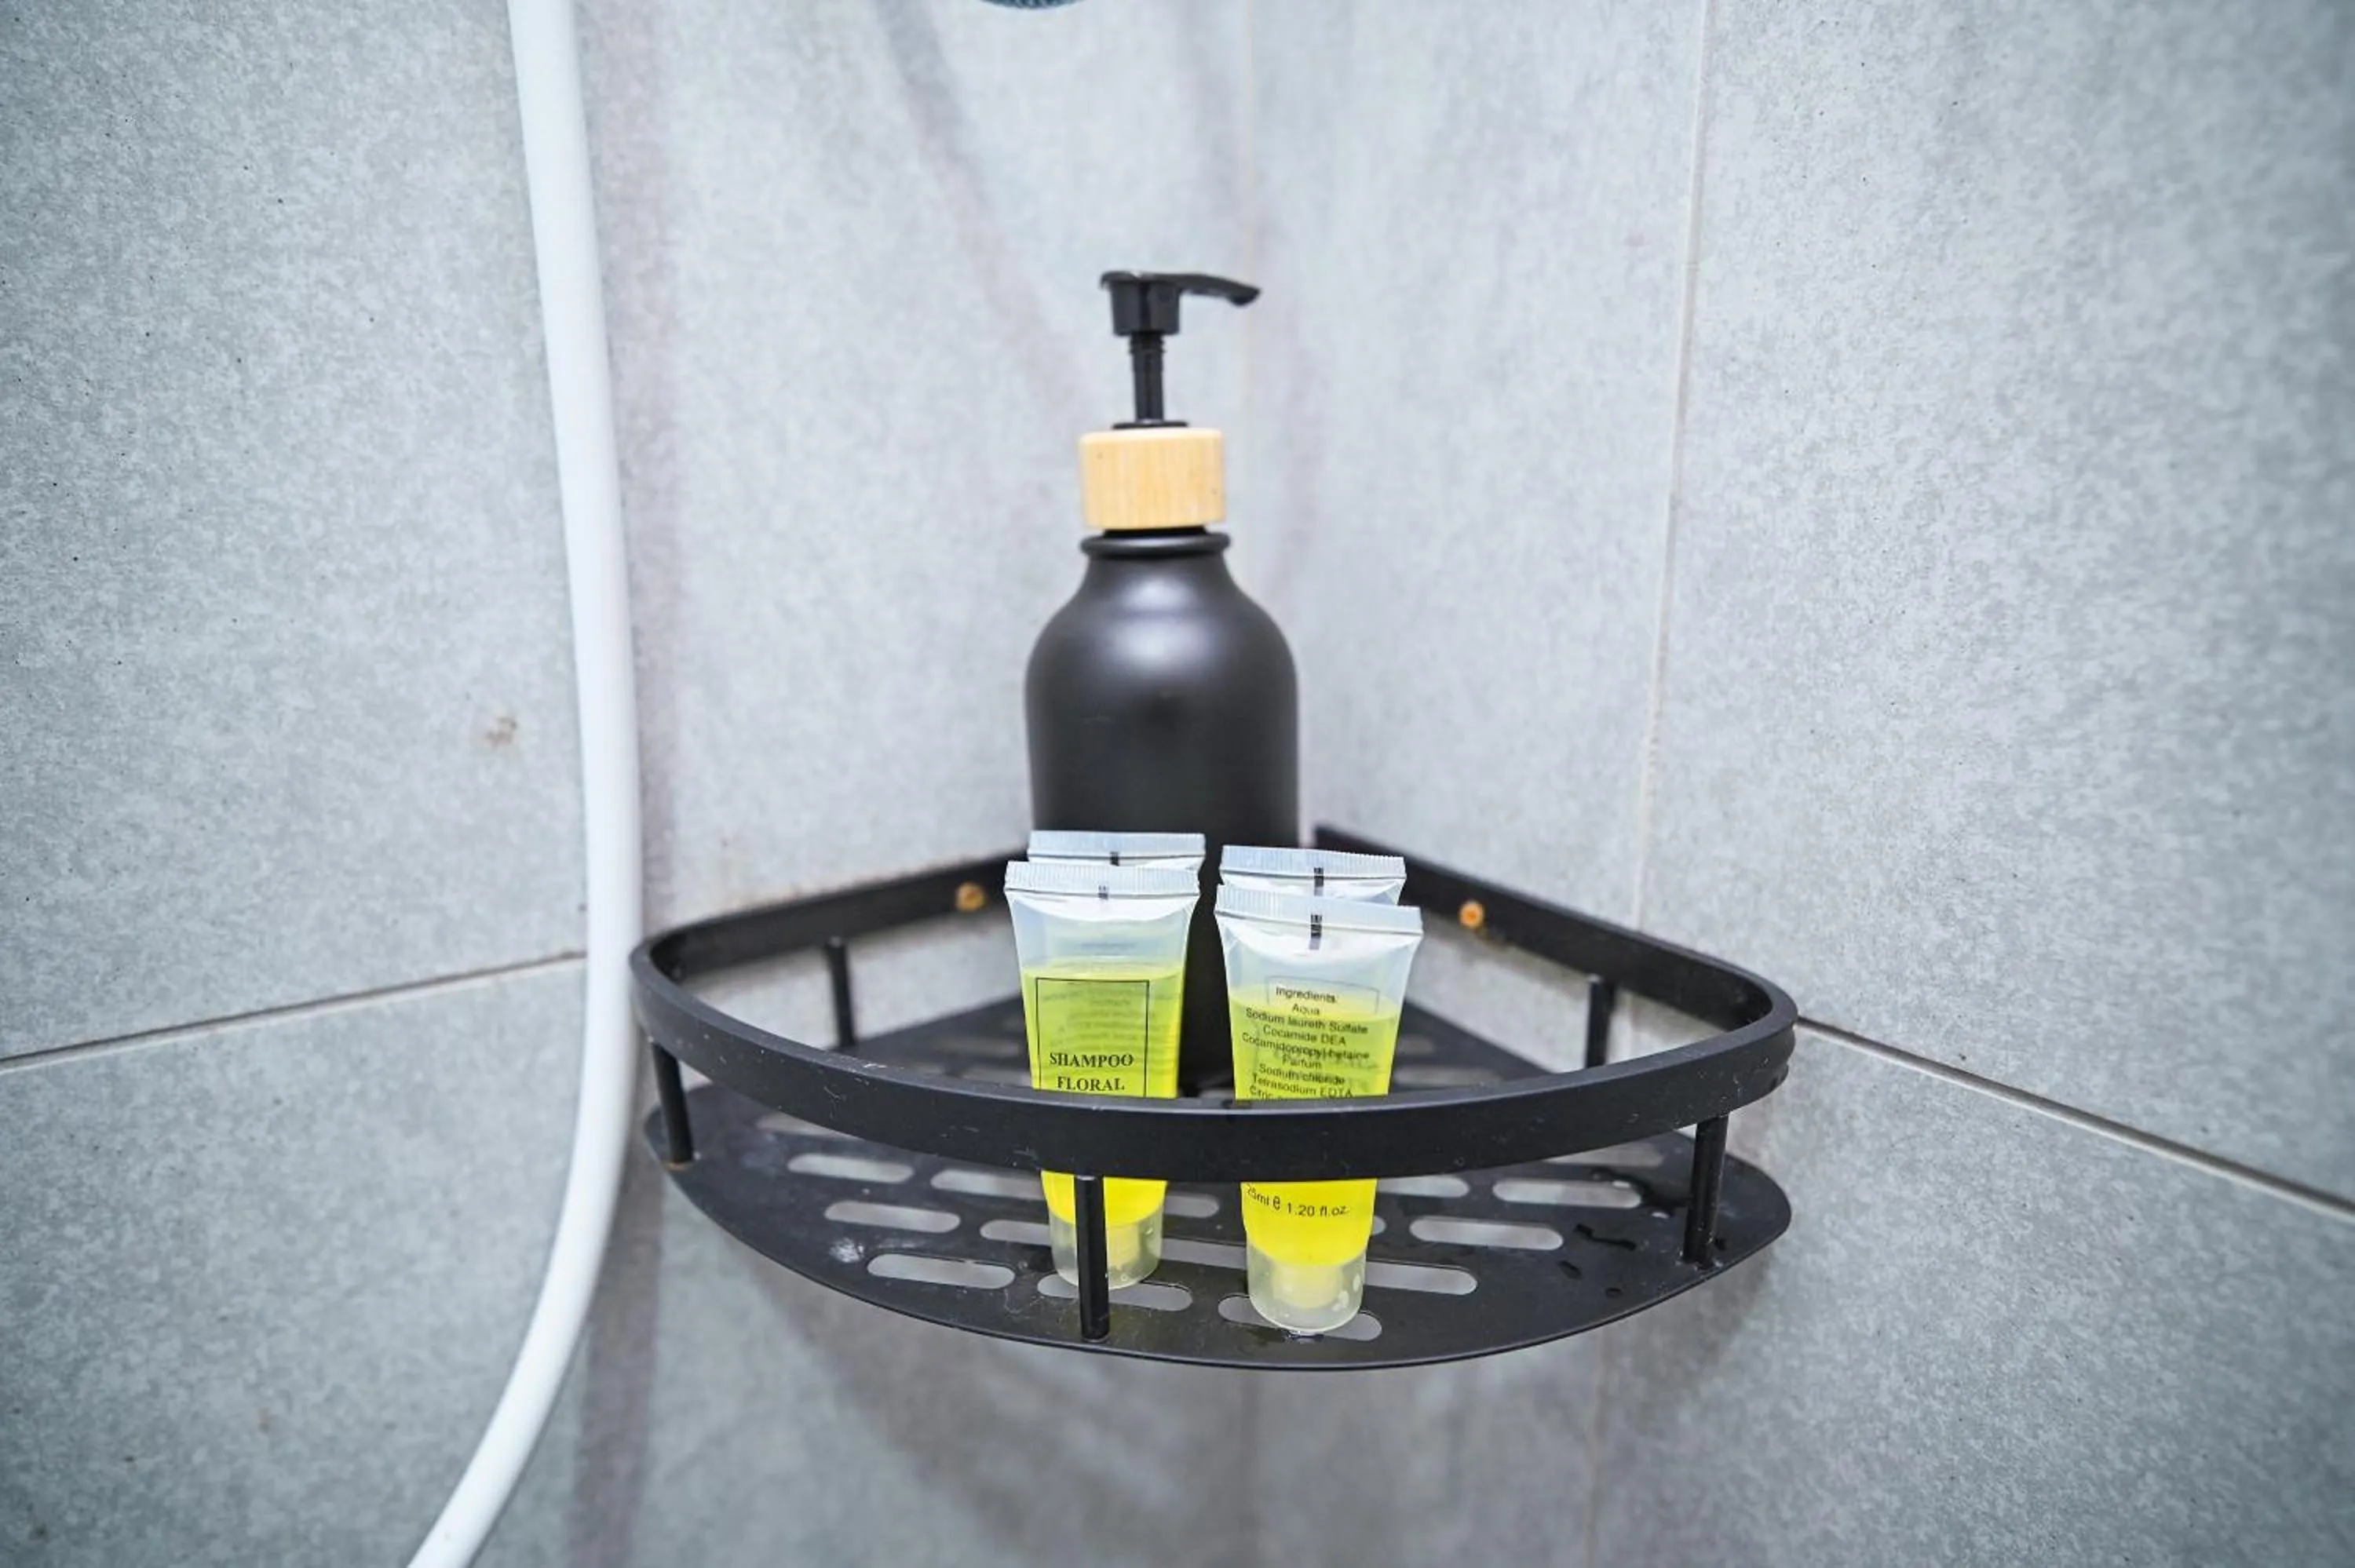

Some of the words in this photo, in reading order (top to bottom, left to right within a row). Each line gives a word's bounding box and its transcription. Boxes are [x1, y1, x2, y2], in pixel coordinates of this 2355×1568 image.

[1245, 1008, 1285, 1023] Sodium
[1263, 1024, 1317, 1042] Cocamide
[1321, 1034, 1346, 1045] DEA
[1050, 1052, 1134, 1068] SHAMPOO
[1282, 1054, 1322, 1069] Parfum
[1057, 1076, 1125, 1092] FLORAL
[1287, 1202, 1315, 1216] 1.20
